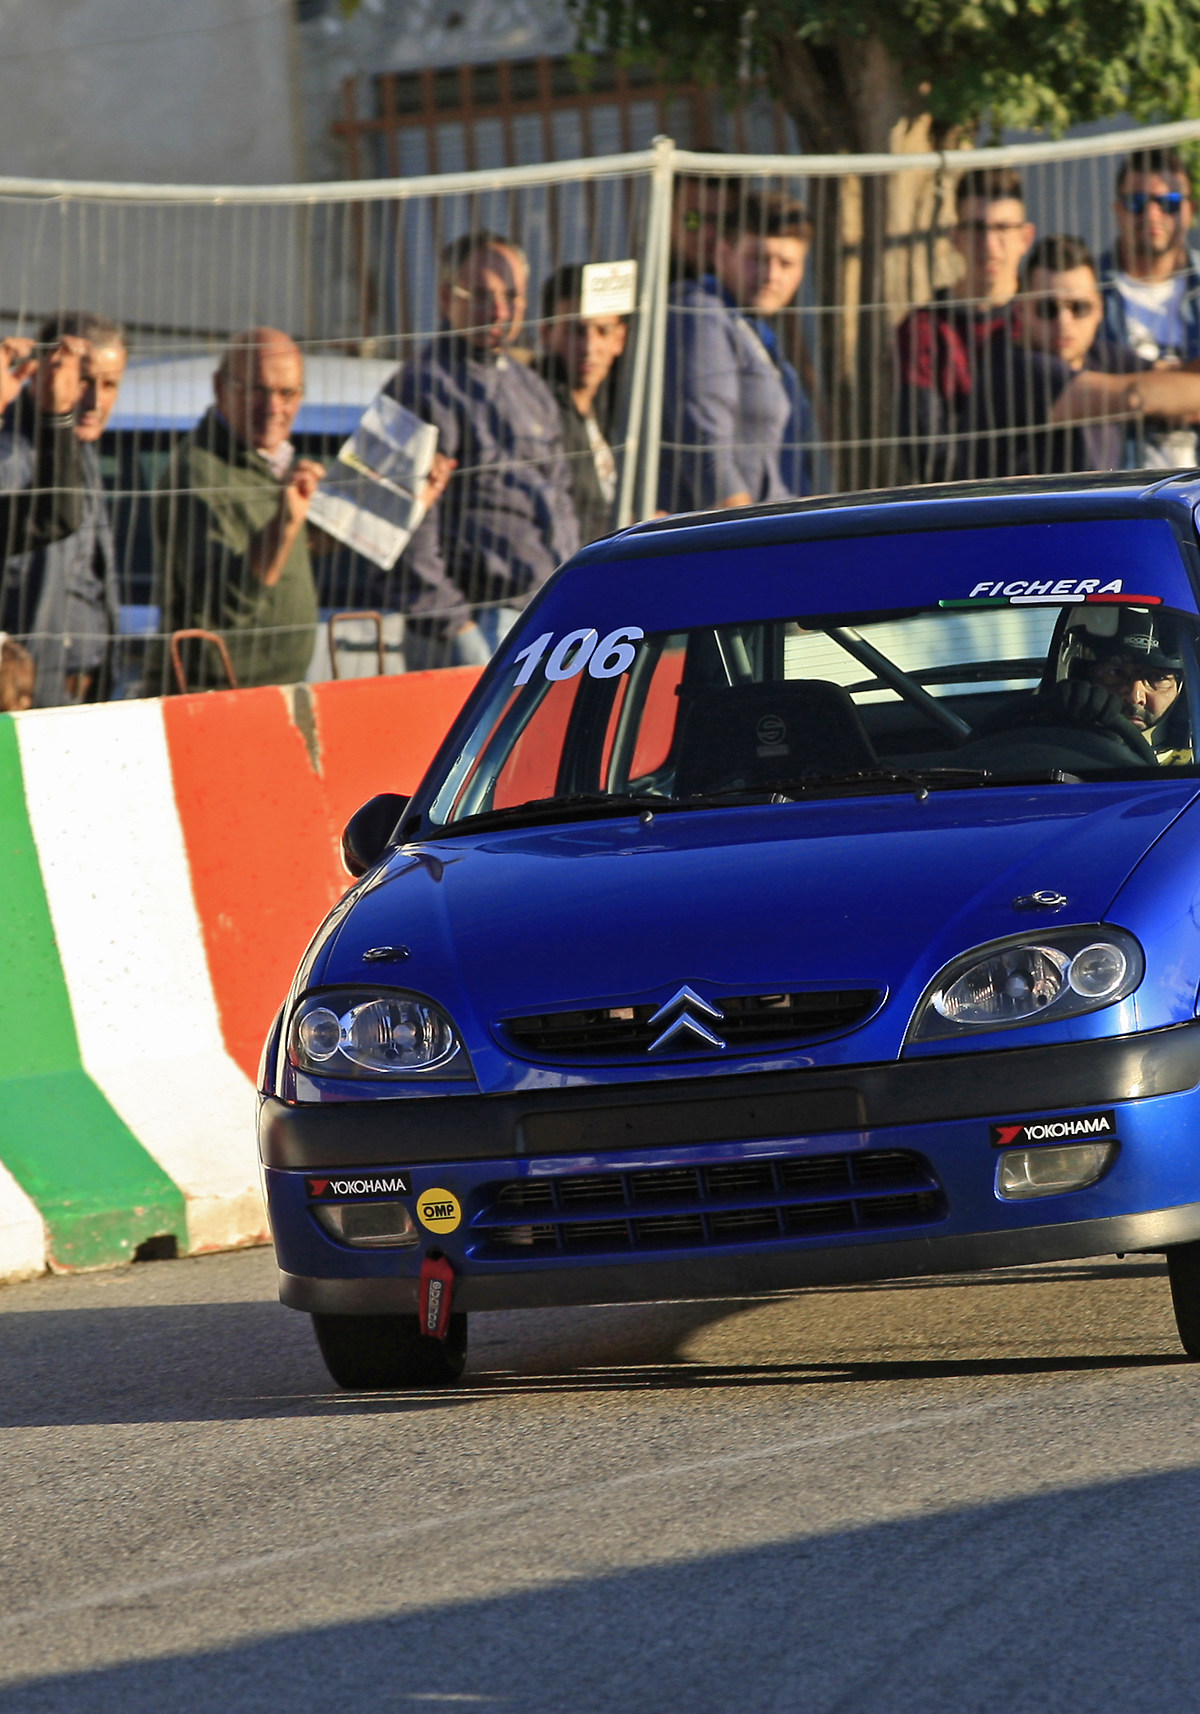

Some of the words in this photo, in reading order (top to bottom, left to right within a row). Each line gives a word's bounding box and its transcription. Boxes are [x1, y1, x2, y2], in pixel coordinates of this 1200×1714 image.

[969, 579, 1122, 597] FICHERA
[513, 626, 644, 686] 106
[1024, 1116, 1111, 1140] YOKOHAMA
[329, 1178, 406, 1195] YOKOHAMA
[423, 1203, 455, 1219] OMP
